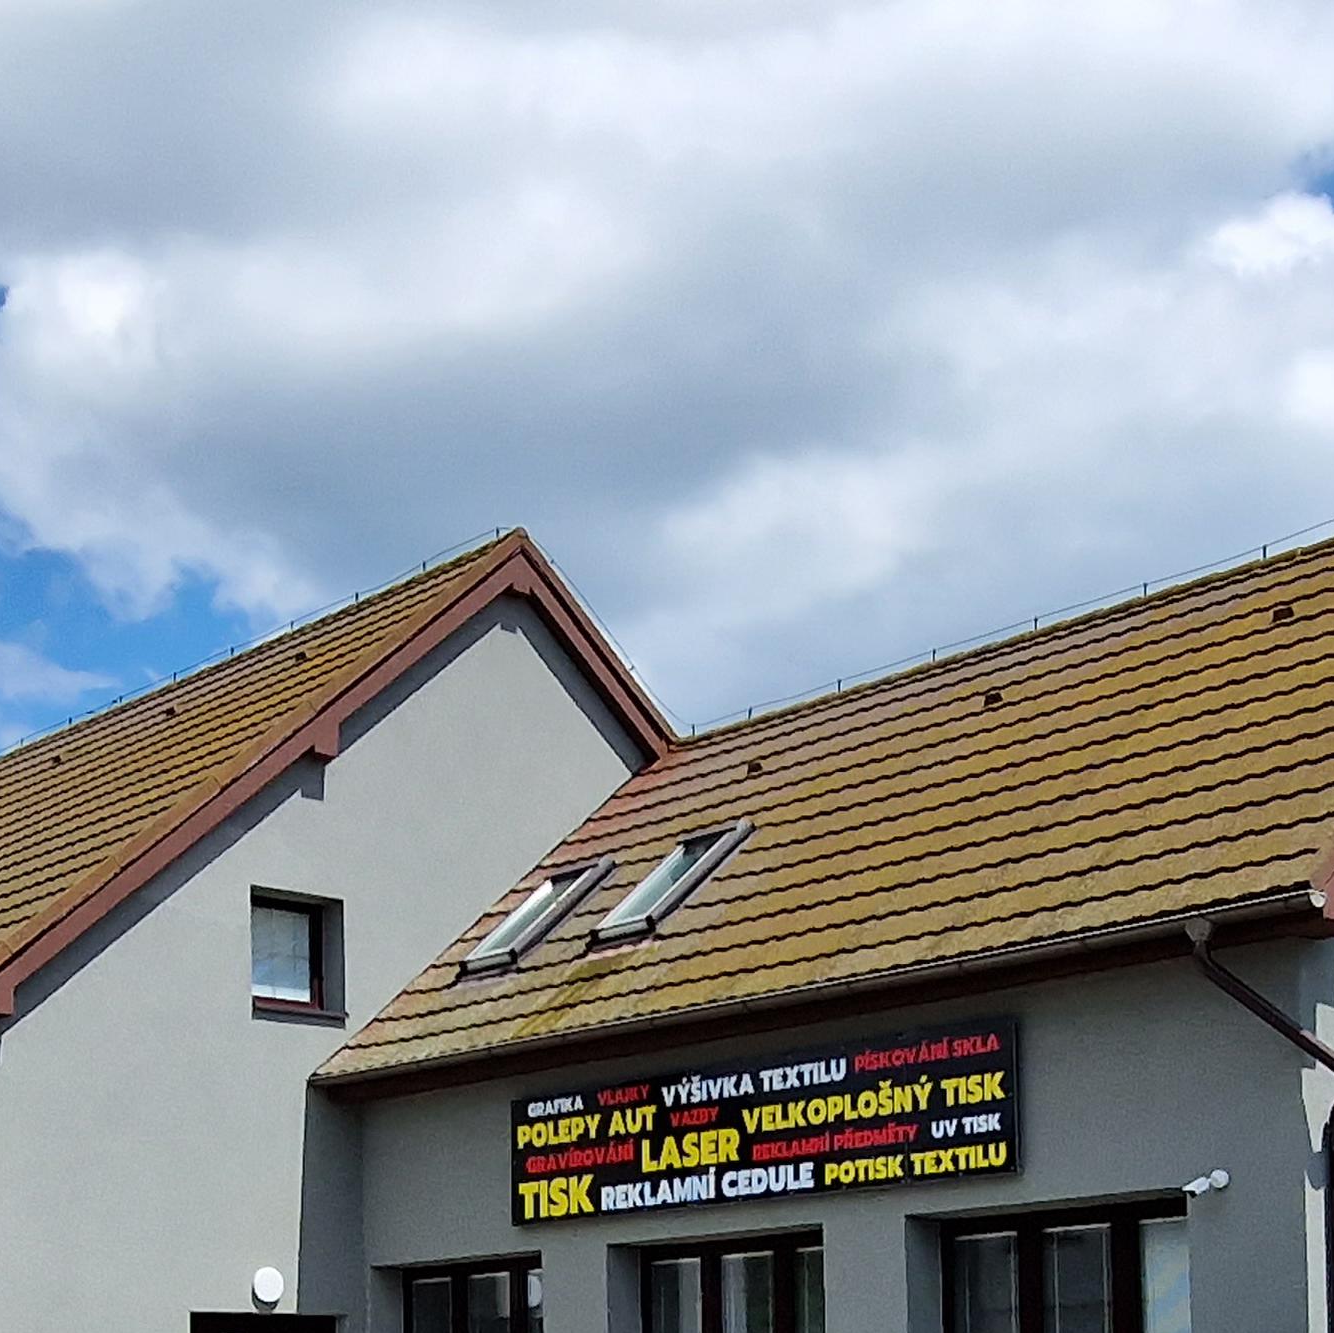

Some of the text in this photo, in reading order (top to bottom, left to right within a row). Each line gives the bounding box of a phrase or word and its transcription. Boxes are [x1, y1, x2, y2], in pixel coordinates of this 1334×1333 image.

[854, 1033, 1001, 1072] PÍSKOVÁNÍ SKLA
[661, 1054, 847, 1107] VÝŠIVKA TEXTILU
[527, 1095, 584, 1118] GRAFIKA
[670, 1106, 720, 1127] VAZBY
[742, 1070, 1007, 1134] VELKOPLOŠNÝ TISK
[517, 1105, 657, 1149] POLEPY AUT
[752, 1122, 919, 1161] REKLAMNÍ PŘEDMĚTY
[931, 1112, 1002, 1139] UV TISK
[526, 1140, 635, 1174] GRAVÍROVÁNÍ
[641, 1128, 740, 1173] LASER
[824, 1141, 1007, 1186] POTISK TEXTILU
[518, 1161, 815, 1219] TISK REKLAMNÍ CEDULE
